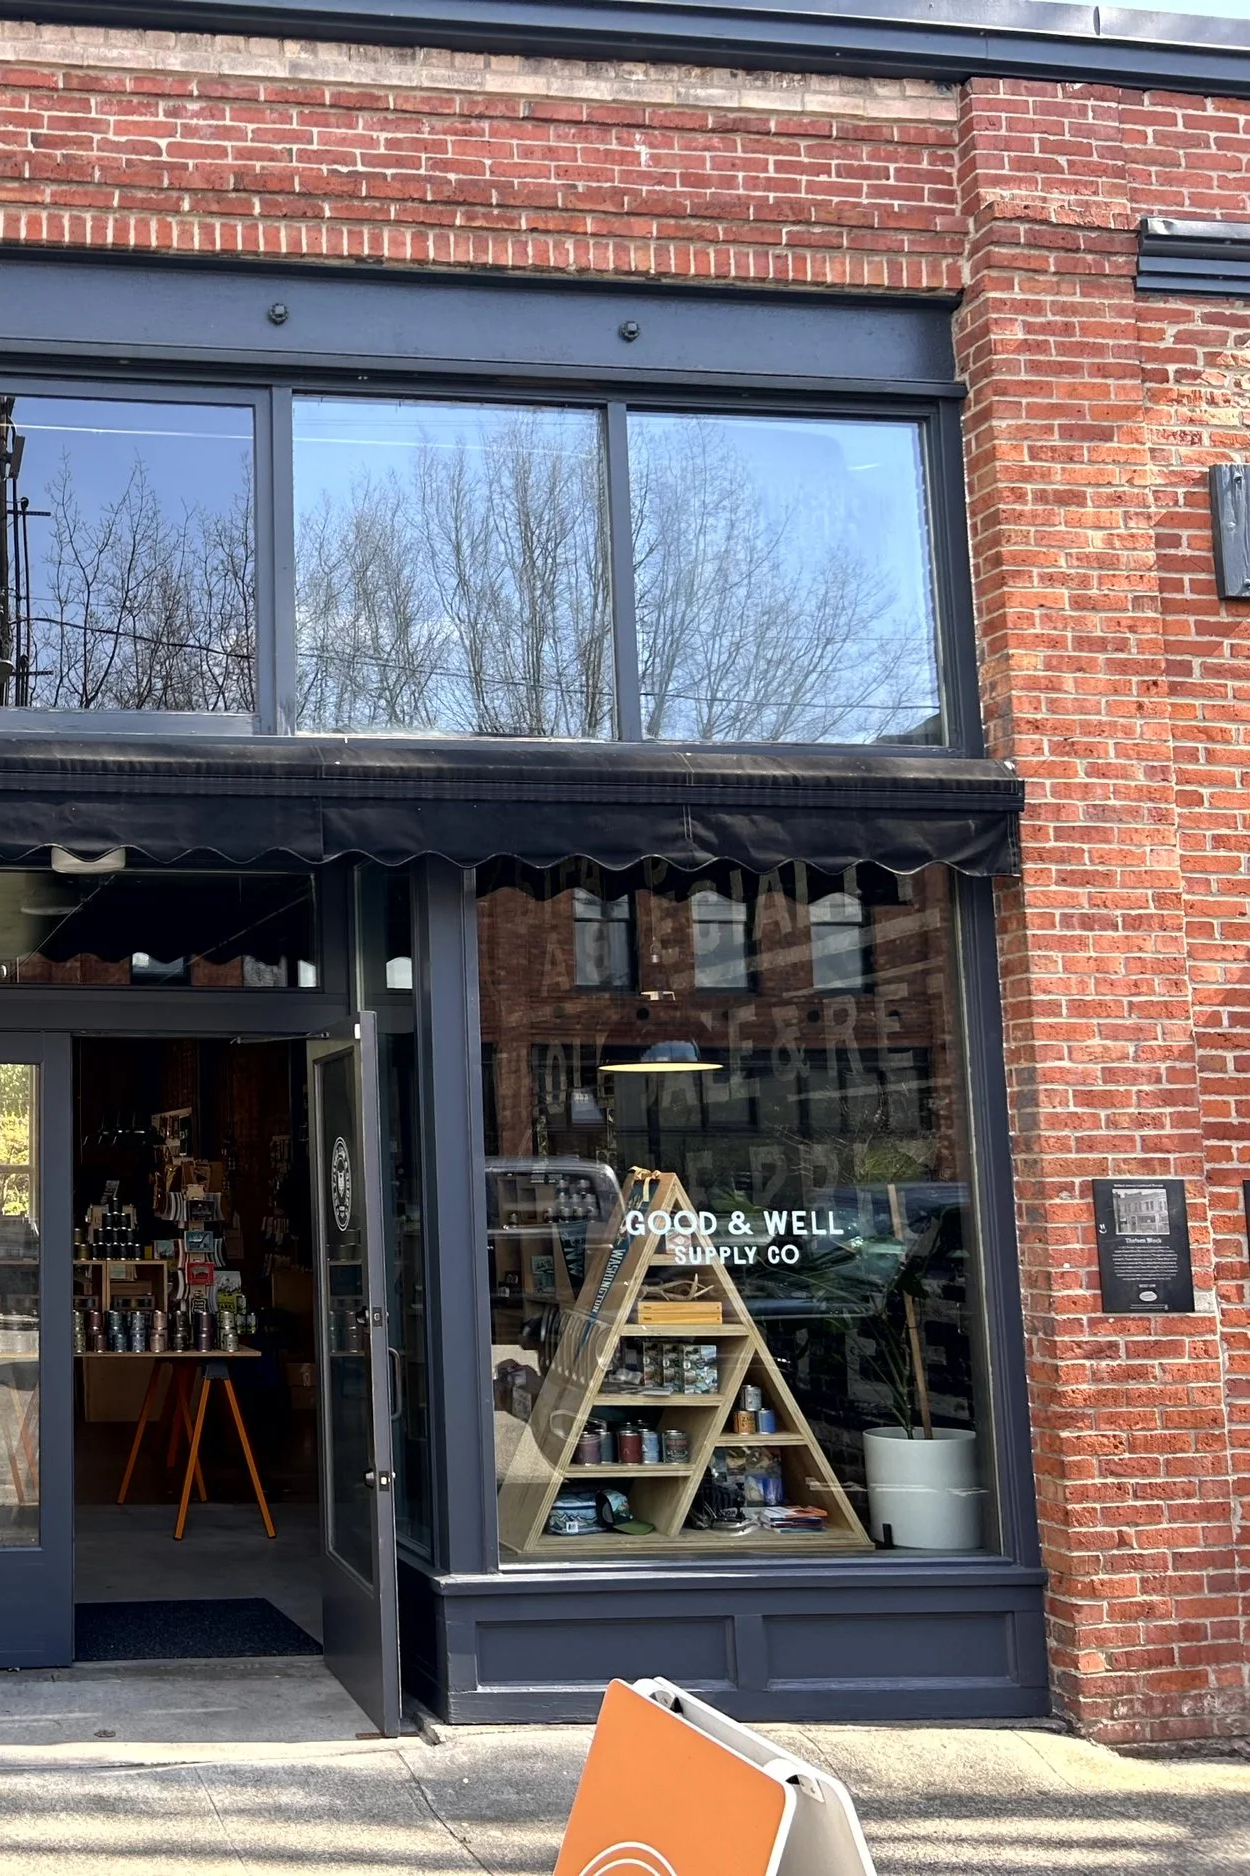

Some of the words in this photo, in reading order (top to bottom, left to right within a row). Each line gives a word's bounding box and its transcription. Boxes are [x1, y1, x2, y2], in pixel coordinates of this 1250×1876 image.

[626, 1210, 717, 1236] GOOD
[728, 1210, 754, 1235] &
[763, 1210, 844, 1236] WELL
[674, 1246, 757, 1265] SUPPLY
[767, 1244, 800, 1265] CO
[591, 1248, 626, 1315] WASHINGTON
